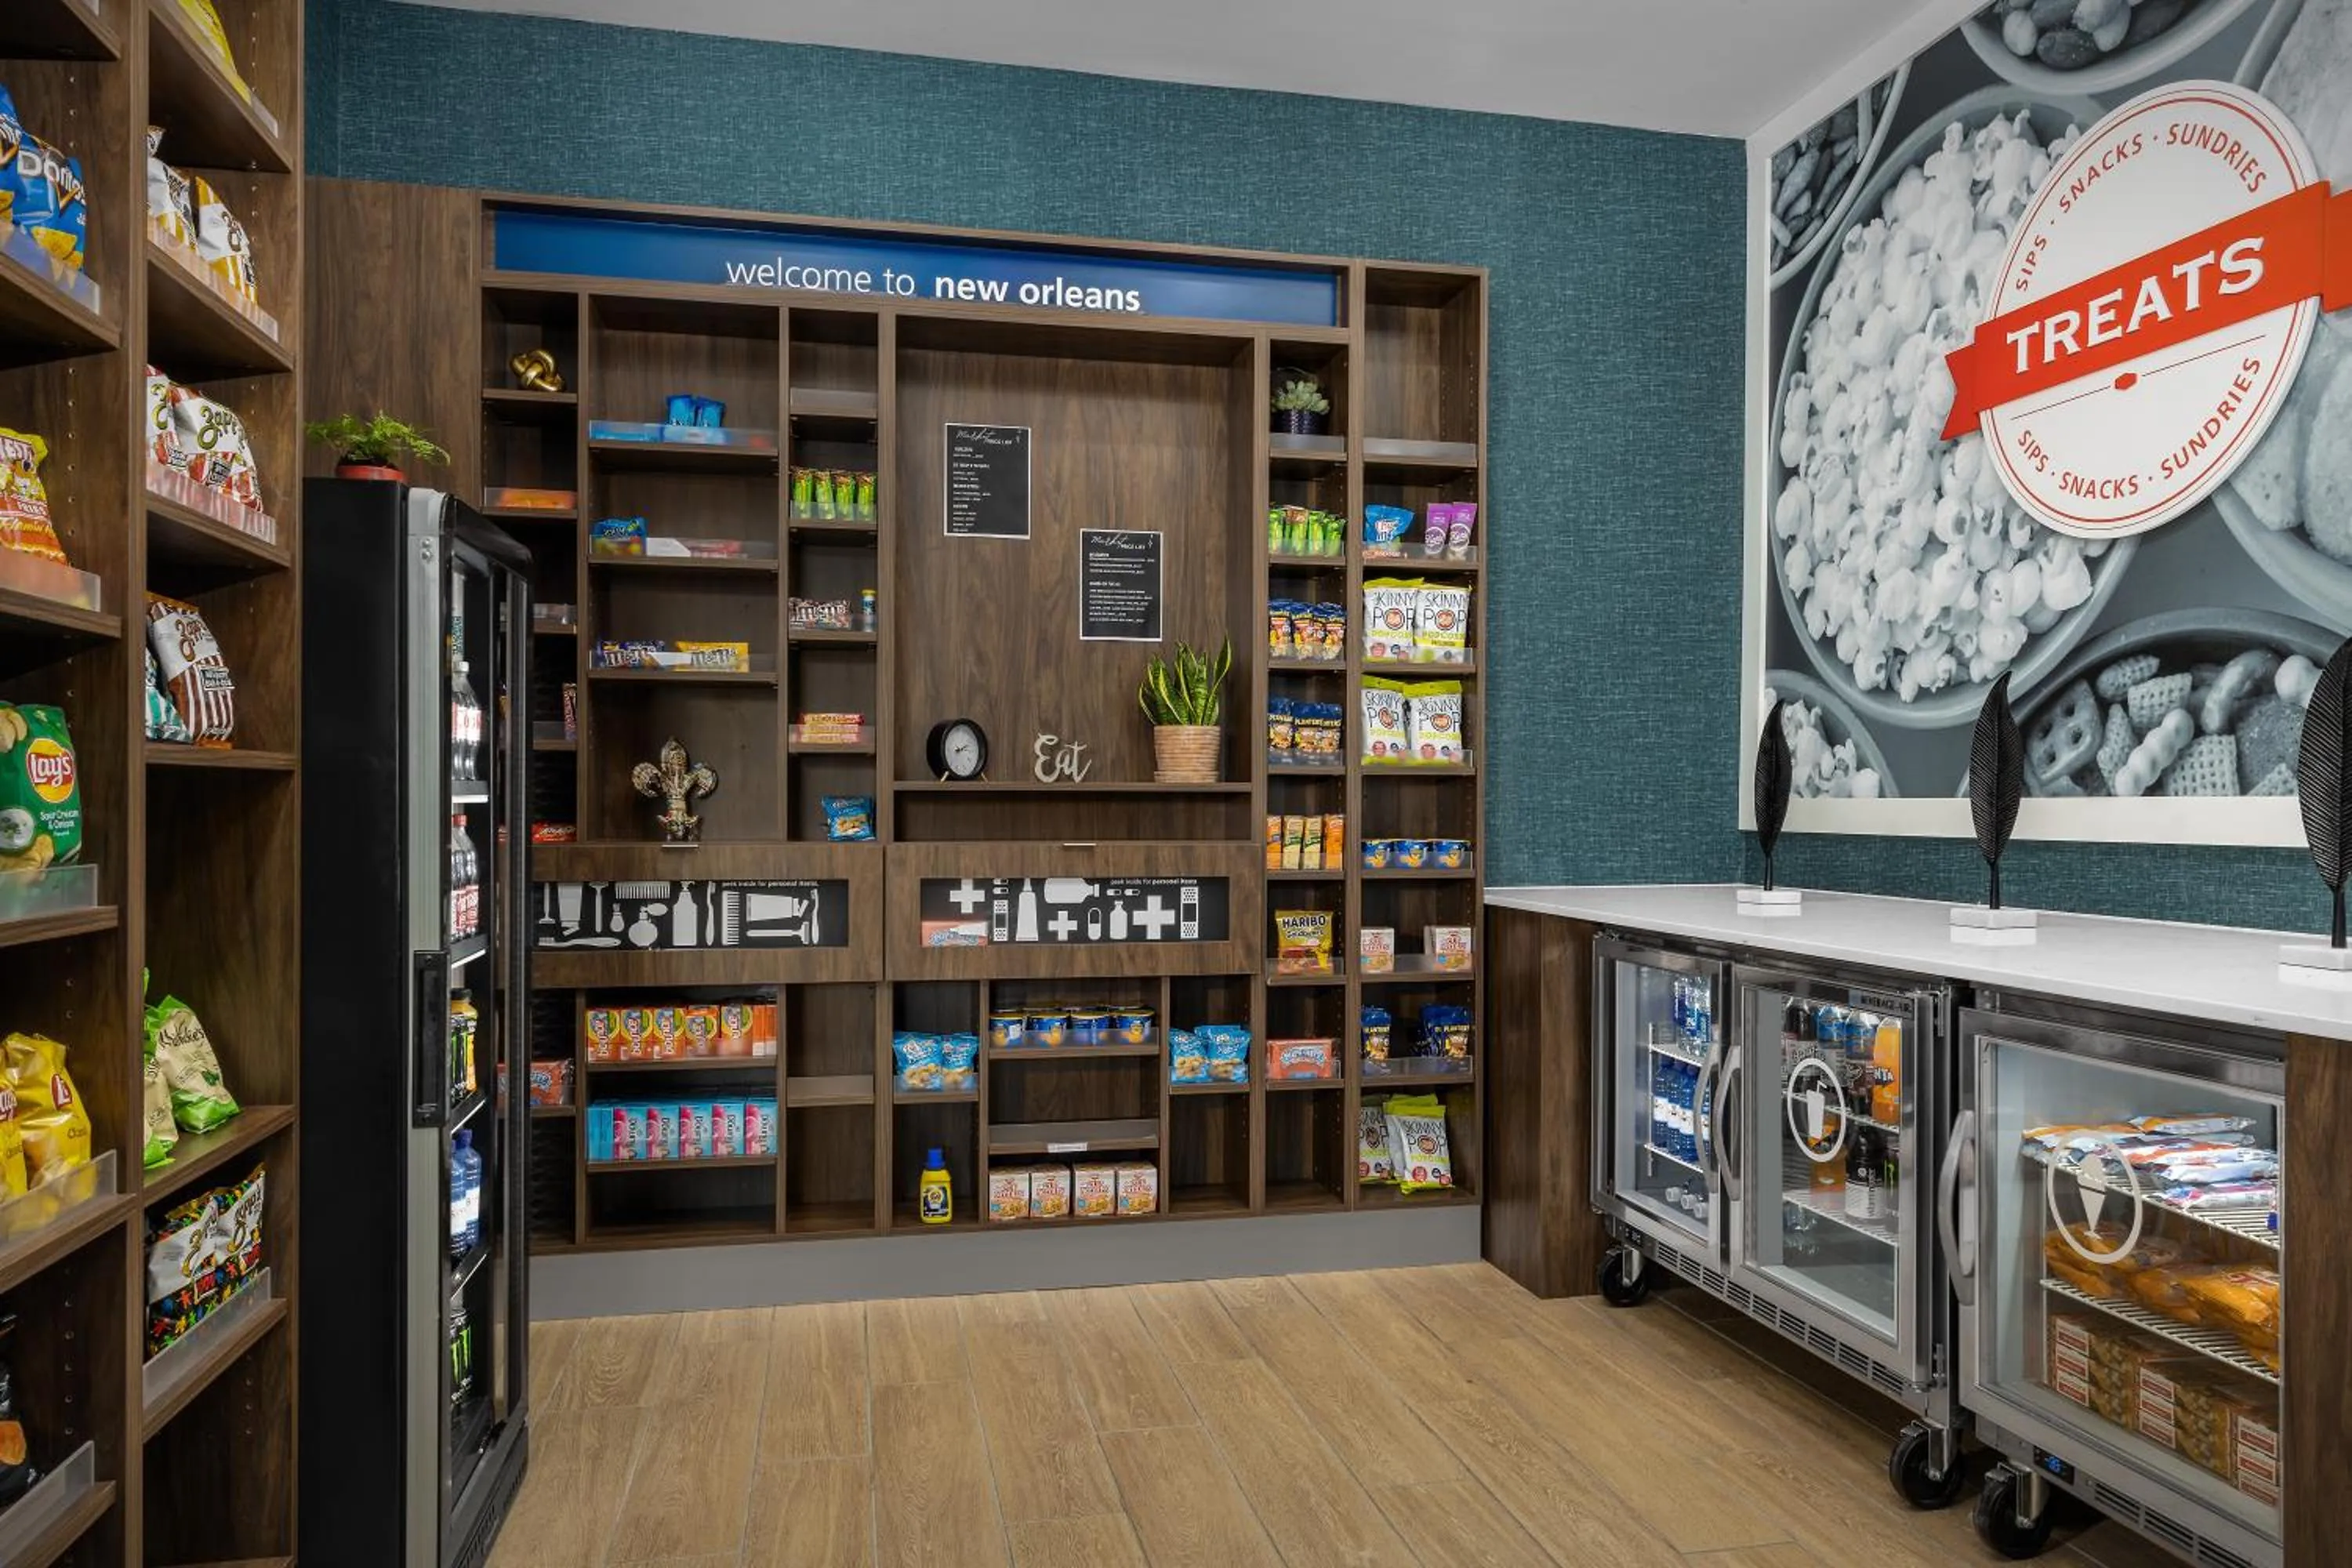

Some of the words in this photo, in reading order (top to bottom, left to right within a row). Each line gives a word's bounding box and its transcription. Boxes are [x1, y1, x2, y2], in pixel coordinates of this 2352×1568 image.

[2016, 234, 2047, 292] SIPS
[2059, 132, 2143, 214] SNACKS
[2166, 122, 2267, 194] SUNDRIES
[727, 257, 872, 293] welcome
[882, 268, 915, 296] to
[935, 274, 1009, 302] new
[1018, 276, 1141, 312] orleans
[2006, 237, 2264, 375] TREATS
[2017, 429, 2049, 473] SIPS
[2058, 471, 2139, 499] SNACKS
[2160, 357, 2262, 480] SUNDRIES
[1373, 607, 1414, 630] POP
[1423, 608, 1466, 632] POP
[1367, 706, 1399, 730] POP
[1418, 711, 1461, 732] POP
[31, 753, 71, 787] Lay's
[1034, 732, 1092, 783] Eat
[1282, 915, 1326, 929] HARIBO
